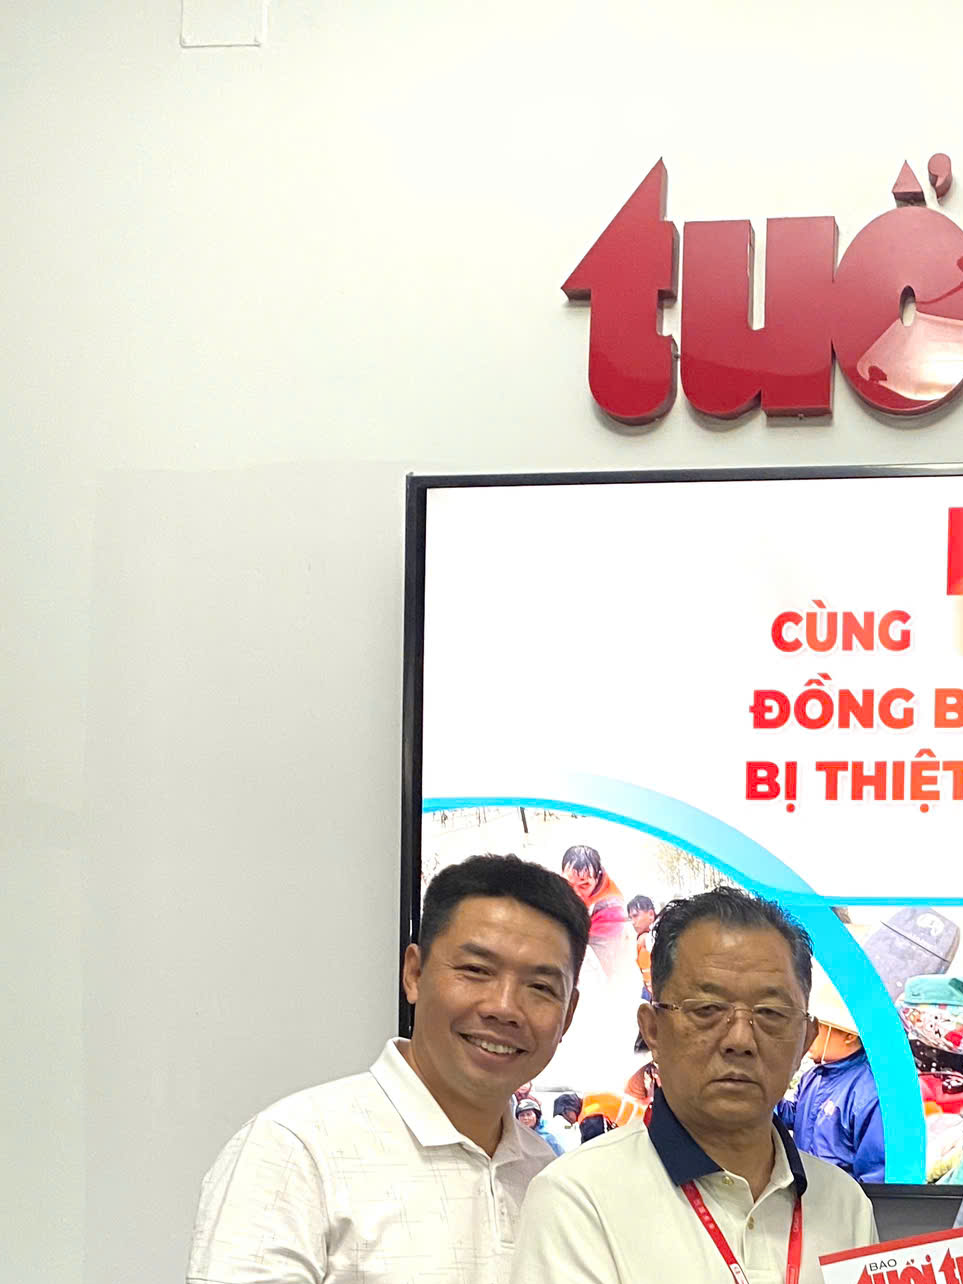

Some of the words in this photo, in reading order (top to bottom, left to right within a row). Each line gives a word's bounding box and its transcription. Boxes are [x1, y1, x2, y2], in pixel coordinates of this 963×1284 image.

[771, 599, 911, 652] CÙNG
[749, 672, 915, 730] ĐỒNG
[745, 760, 798, 813] BỊ
